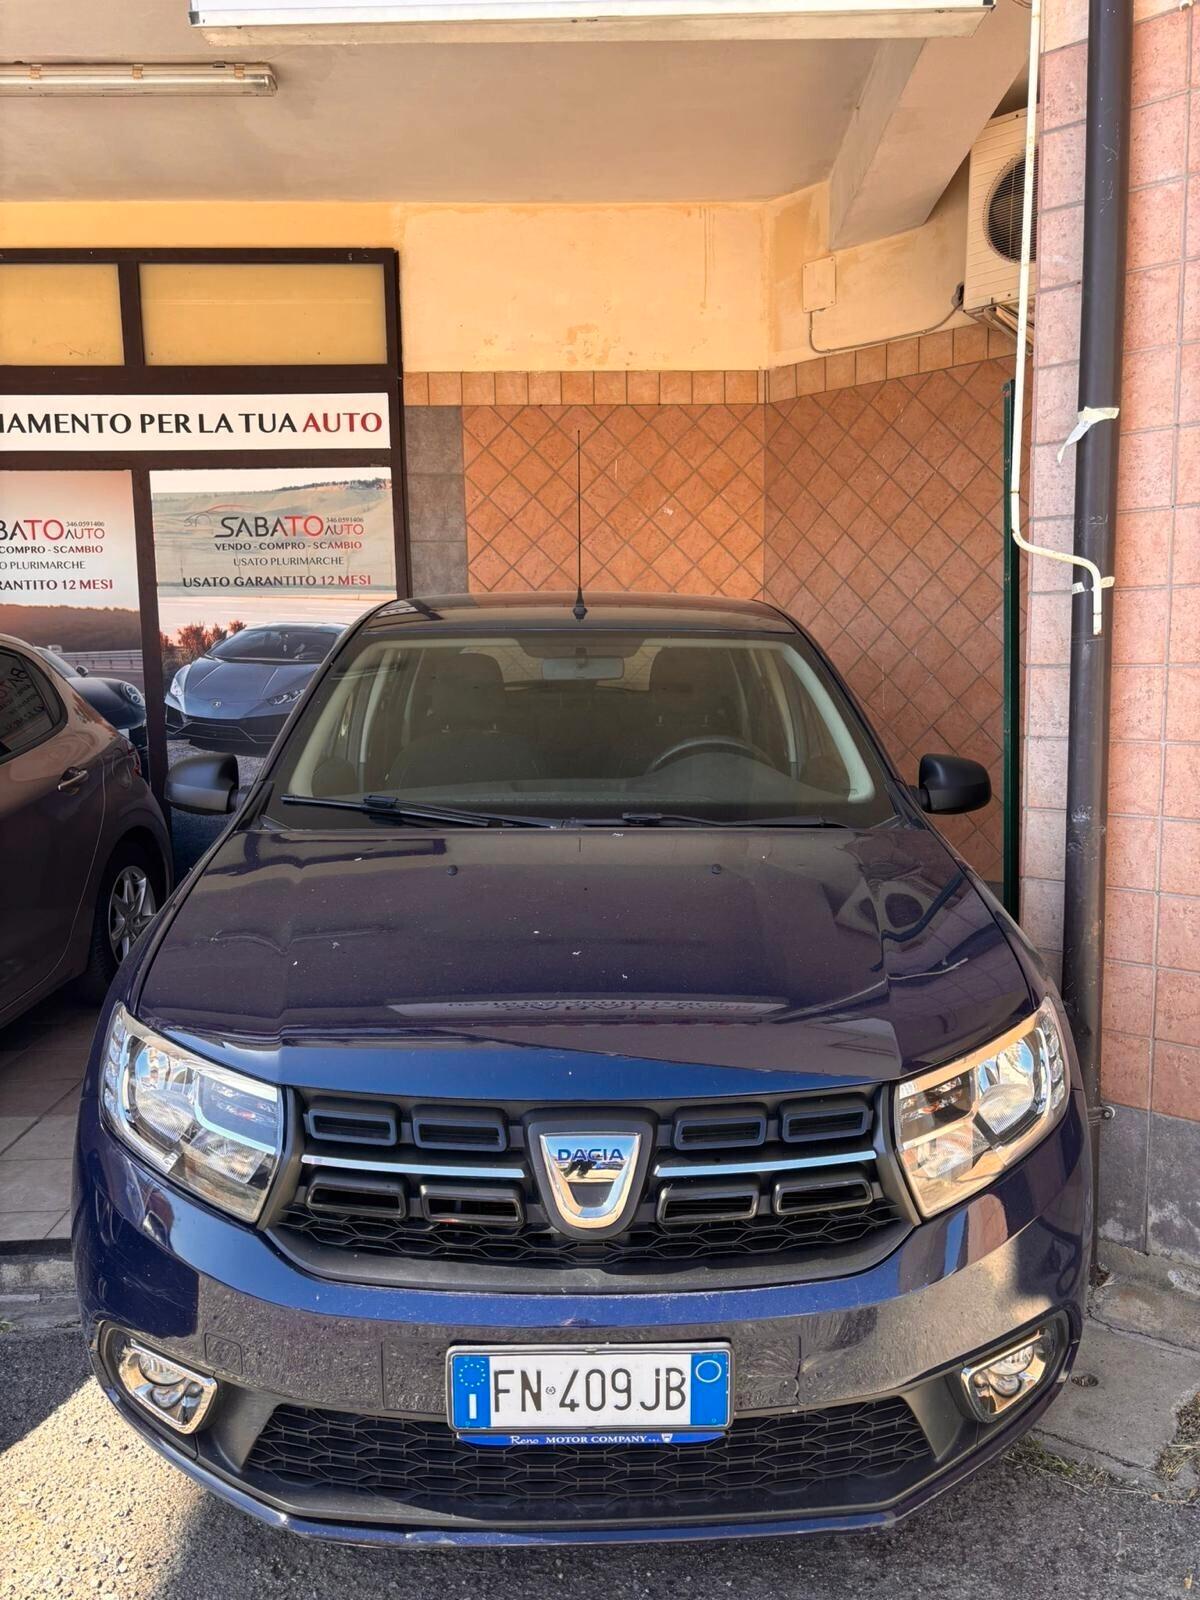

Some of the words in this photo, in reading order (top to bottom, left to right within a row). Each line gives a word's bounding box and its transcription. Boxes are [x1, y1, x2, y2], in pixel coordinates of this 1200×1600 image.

[140, 413, 192, 434] PER
[198, 413, 234, 433] LA
[238, 413, 297, 433] TUA
[302, 412, 382, 433] AUTO
[214, 515, 324, 538] SABATO
[325, 523, 364, 536] AUTO
[65, 527, 105, 540] AUTO
[53, 545, 104, 554] SCAMBIO
[215, 542, 251, 551] VENDO
[259, 542, 306, 551] COMPRO
[313, 541, 362, 550] SCAMBIO
[10, 560, 86, 570] PLURIMARCHE
[233, 558, 269, 567] USATO
[270, 556, 345, 566] PLURIMARCHE
[62, 580, 76, 590] 12
[80, 579, 113, 590] MESI
[182, 576, 230, 588] USATO
[234, 575, 317, 587] GARANTITO
[321, 575, 335, 586] 12
[338, 575, 372, 586] MESI
[557, 1148, 624, 1161] DACIA
[493, 1369, 542, 1413] FN
[545, 1436, 588, 1444] MOTOR
[591, 1435, 648, 1443] COMPANY
